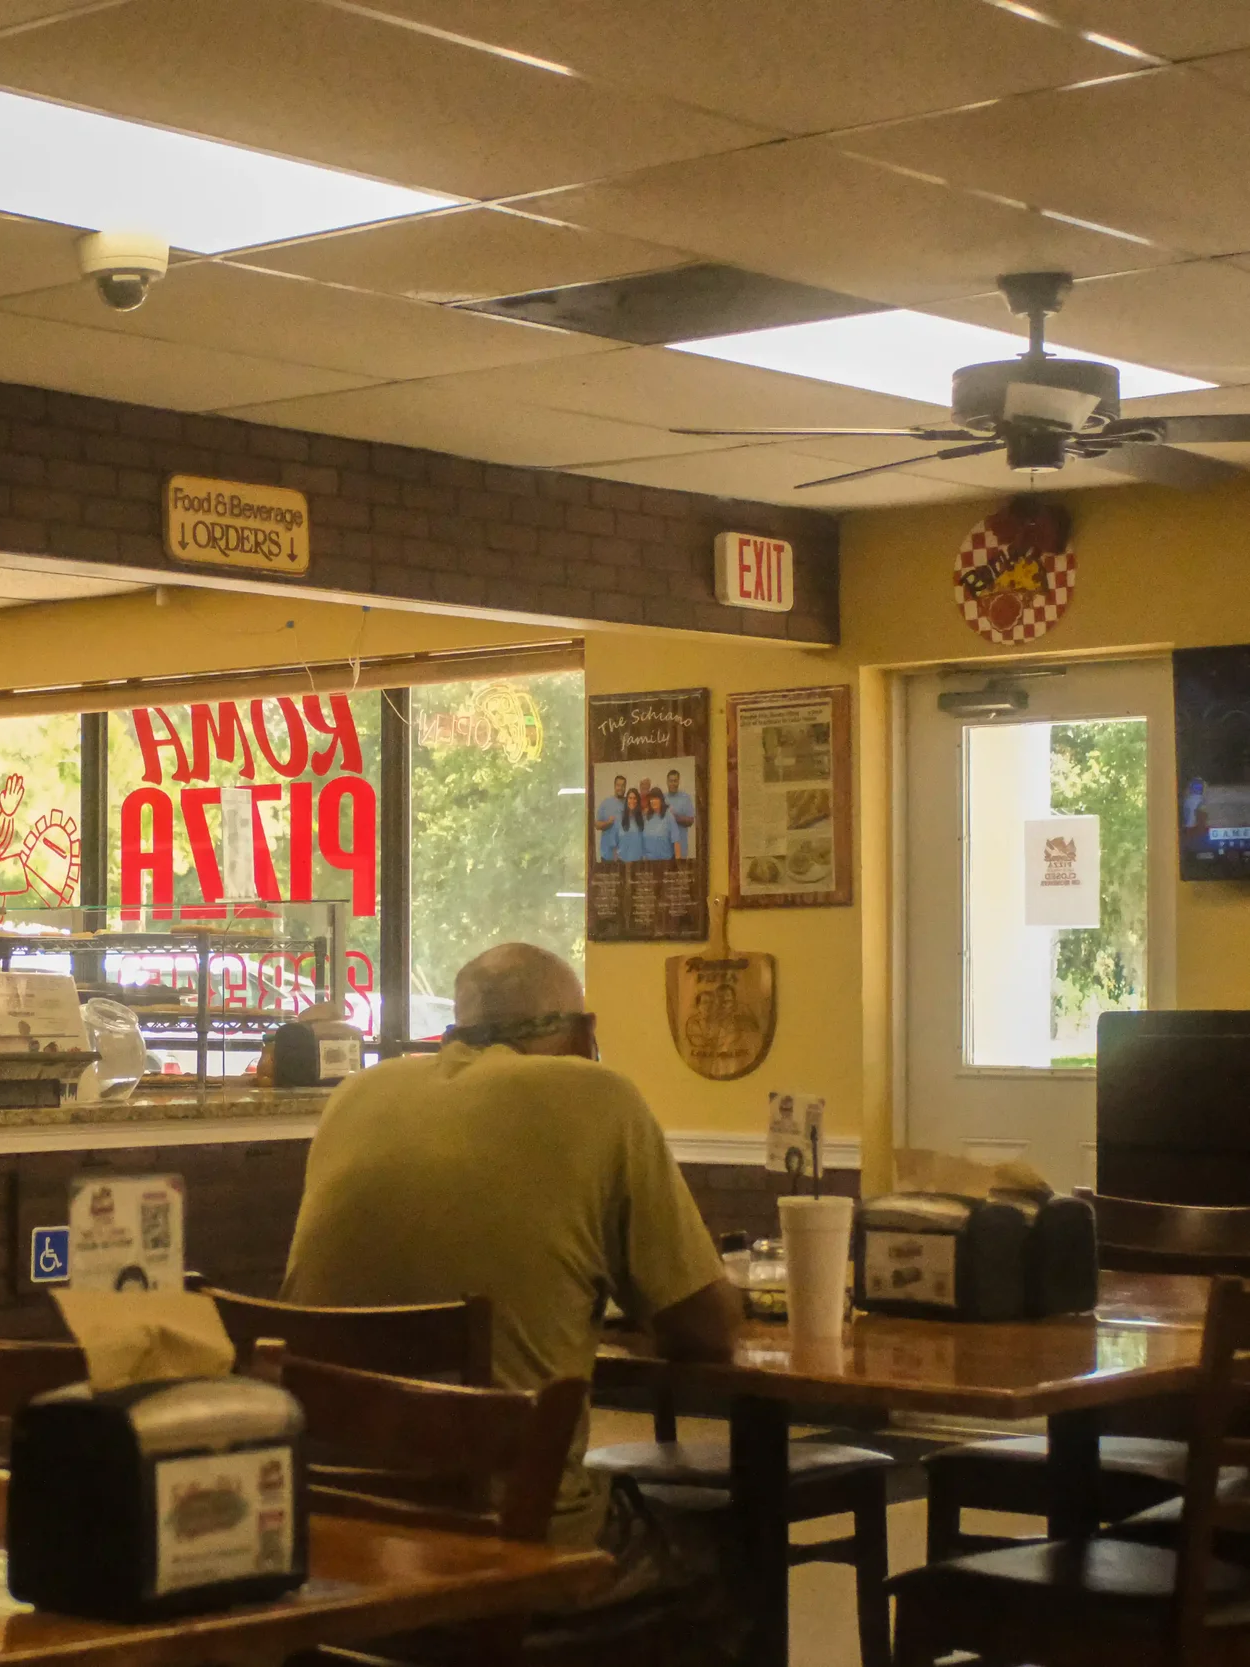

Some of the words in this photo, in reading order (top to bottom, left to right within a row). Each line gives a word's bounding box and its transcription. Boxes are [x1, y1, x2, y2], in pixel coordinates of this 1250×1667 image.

[173, 487, 212, 513] Food
[214, 493, 228, 517] &
[229, 495, 304, 532] Beverage
[192, 520, 282, 562] ORDERS
[738, 537, 785, 604] EXIT
[597, 715, 627, 737] The
[631, 706, 694, 728] Schiano
